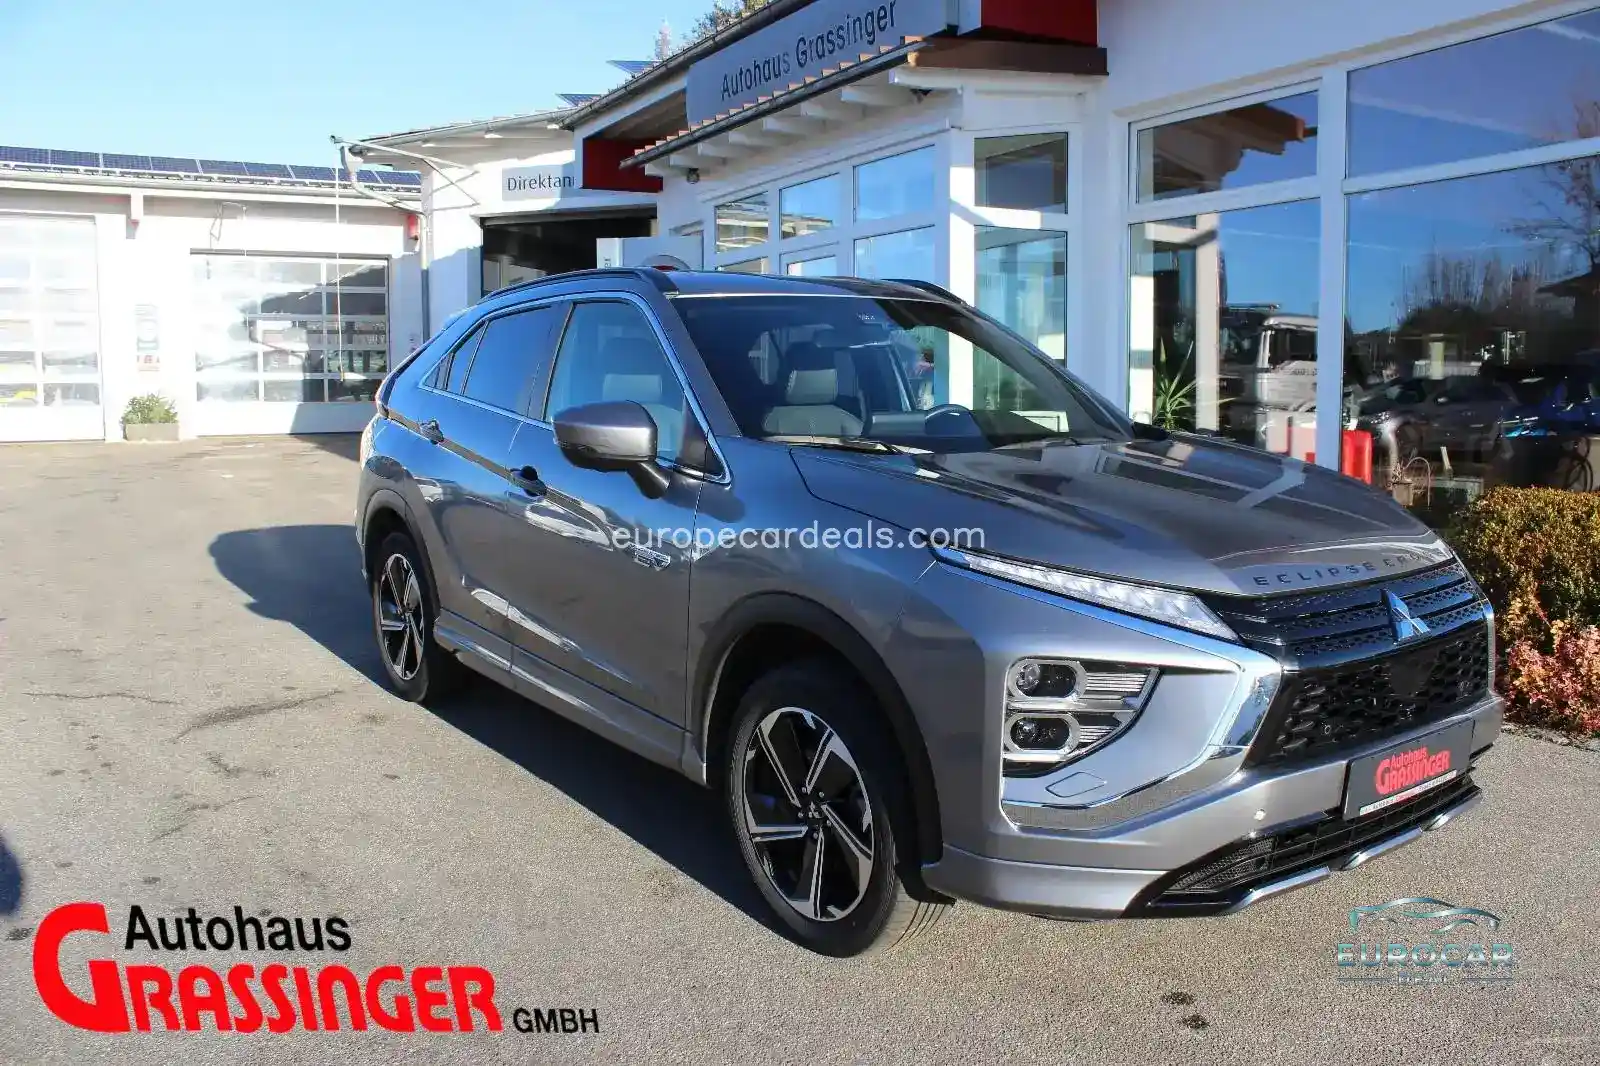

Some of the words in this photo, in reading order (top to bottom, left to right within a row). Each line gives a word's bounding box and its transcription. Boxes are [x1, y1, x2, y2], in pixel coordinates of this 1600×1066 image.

[721, 52, 791, 101] Autohaus
[795, 0, 897, 68] Grassinger
[1252, 561, 1377, 586] ECLIPSE
[1390, 746, 1427, 769] Autohaus
